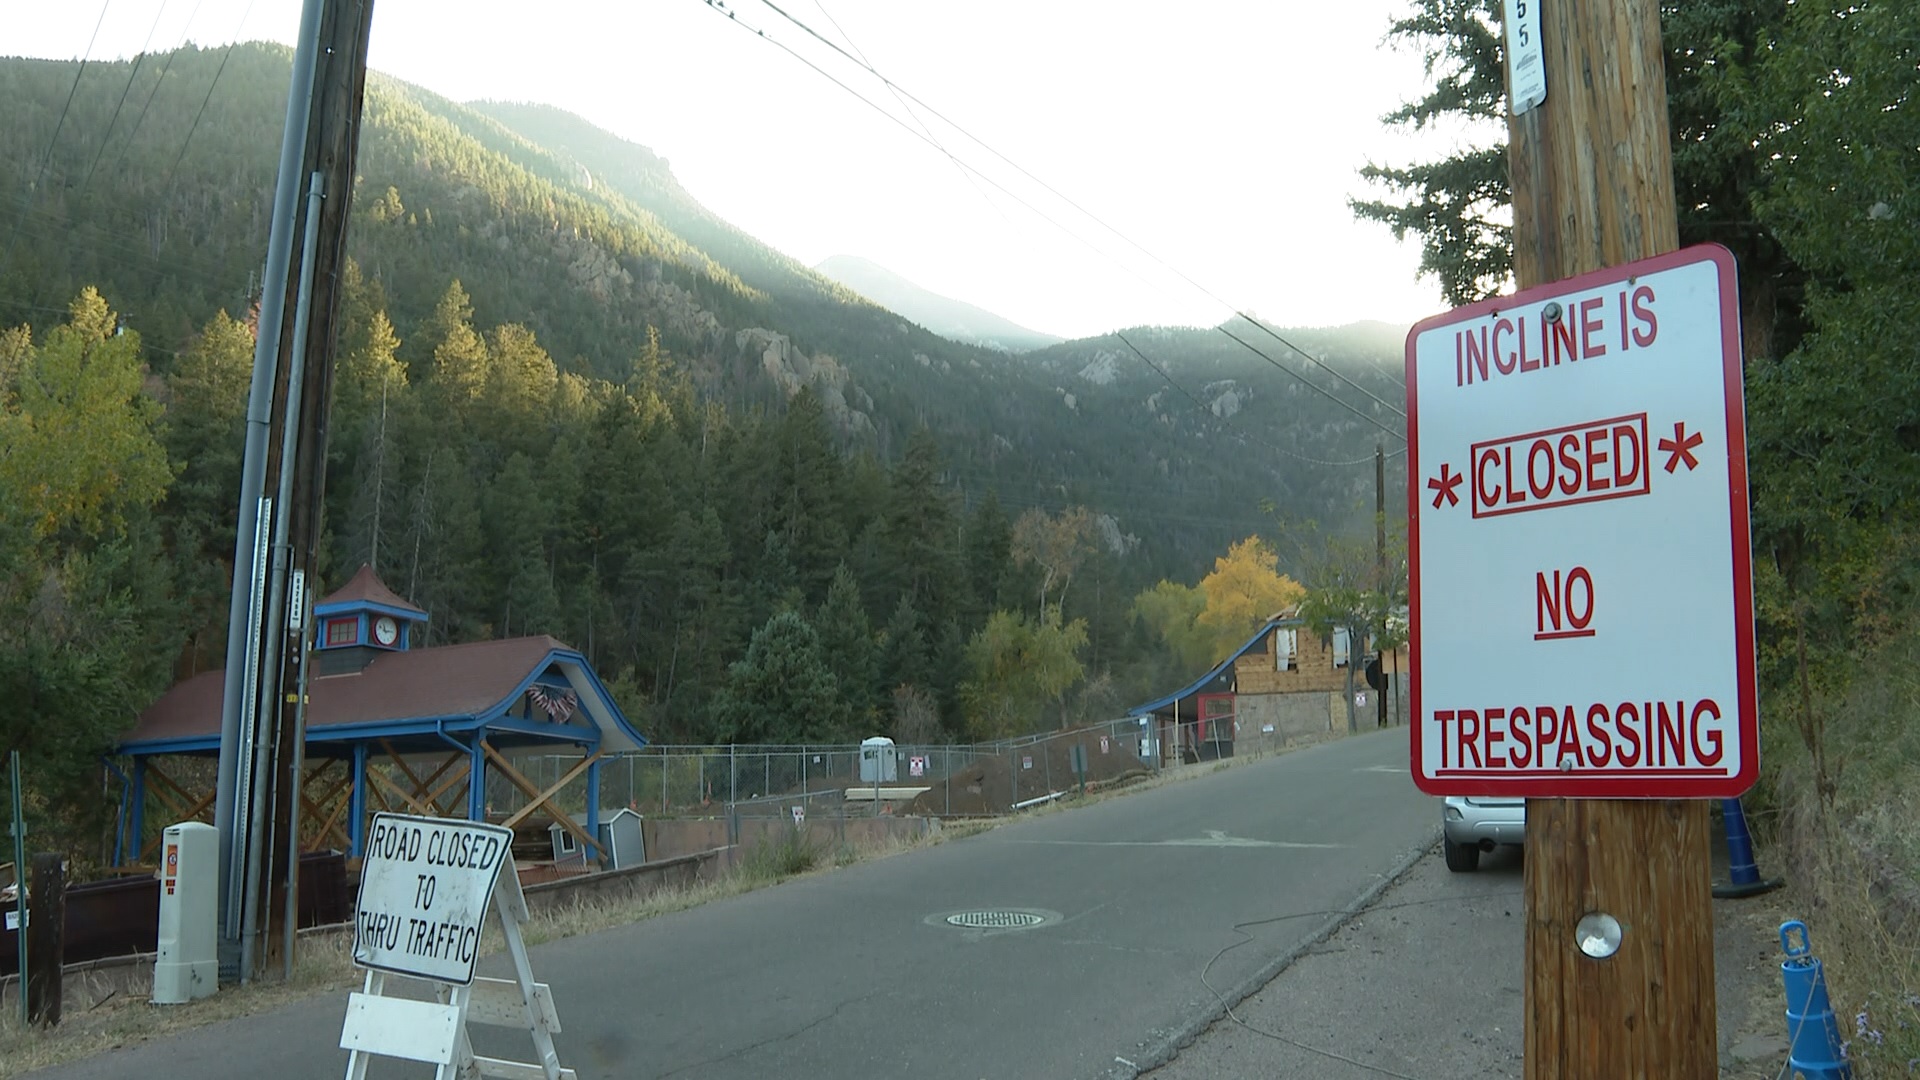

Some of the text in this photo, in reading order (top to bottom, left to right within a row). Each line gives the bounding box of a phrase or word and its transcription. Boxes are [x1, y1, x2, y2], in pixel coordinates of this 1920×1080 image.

[1456, 286, 1658, 387] INCLINE IS
[1478, 424, 1641, 508] CLOSED
[1536, 566, 1594, 632] NO
[1435, 699, 1723, 769] TRESPASSING
[372, 824, 496, 870] ROAD CLOSED
[414, 874, 436, 911] TO
[360, 911, 475, 964] THRU TRAFFIC
